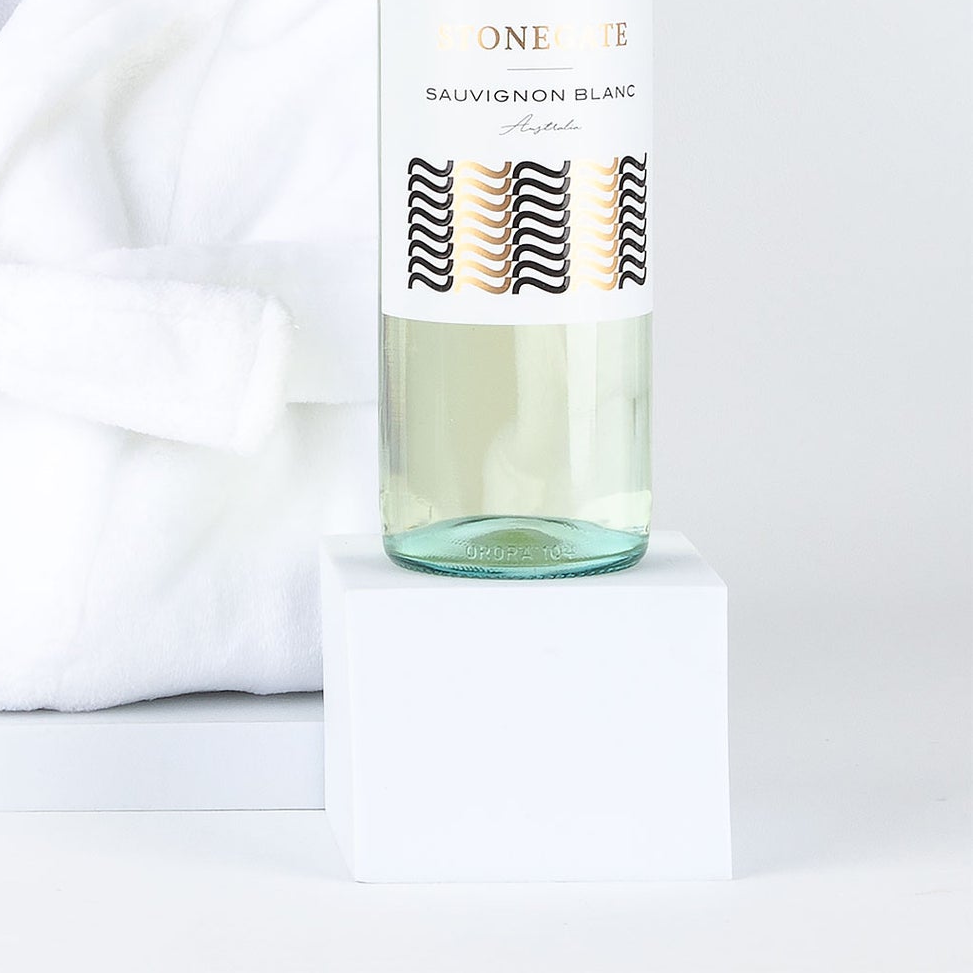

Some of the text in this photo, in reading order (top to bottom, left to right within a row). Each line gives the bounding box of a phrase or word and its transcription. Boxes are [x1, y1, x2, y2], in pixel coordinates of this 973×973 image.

[426, 84, 636, 103] SAUVIGNON BLANC
[499, 113, 582, 135] Australia
